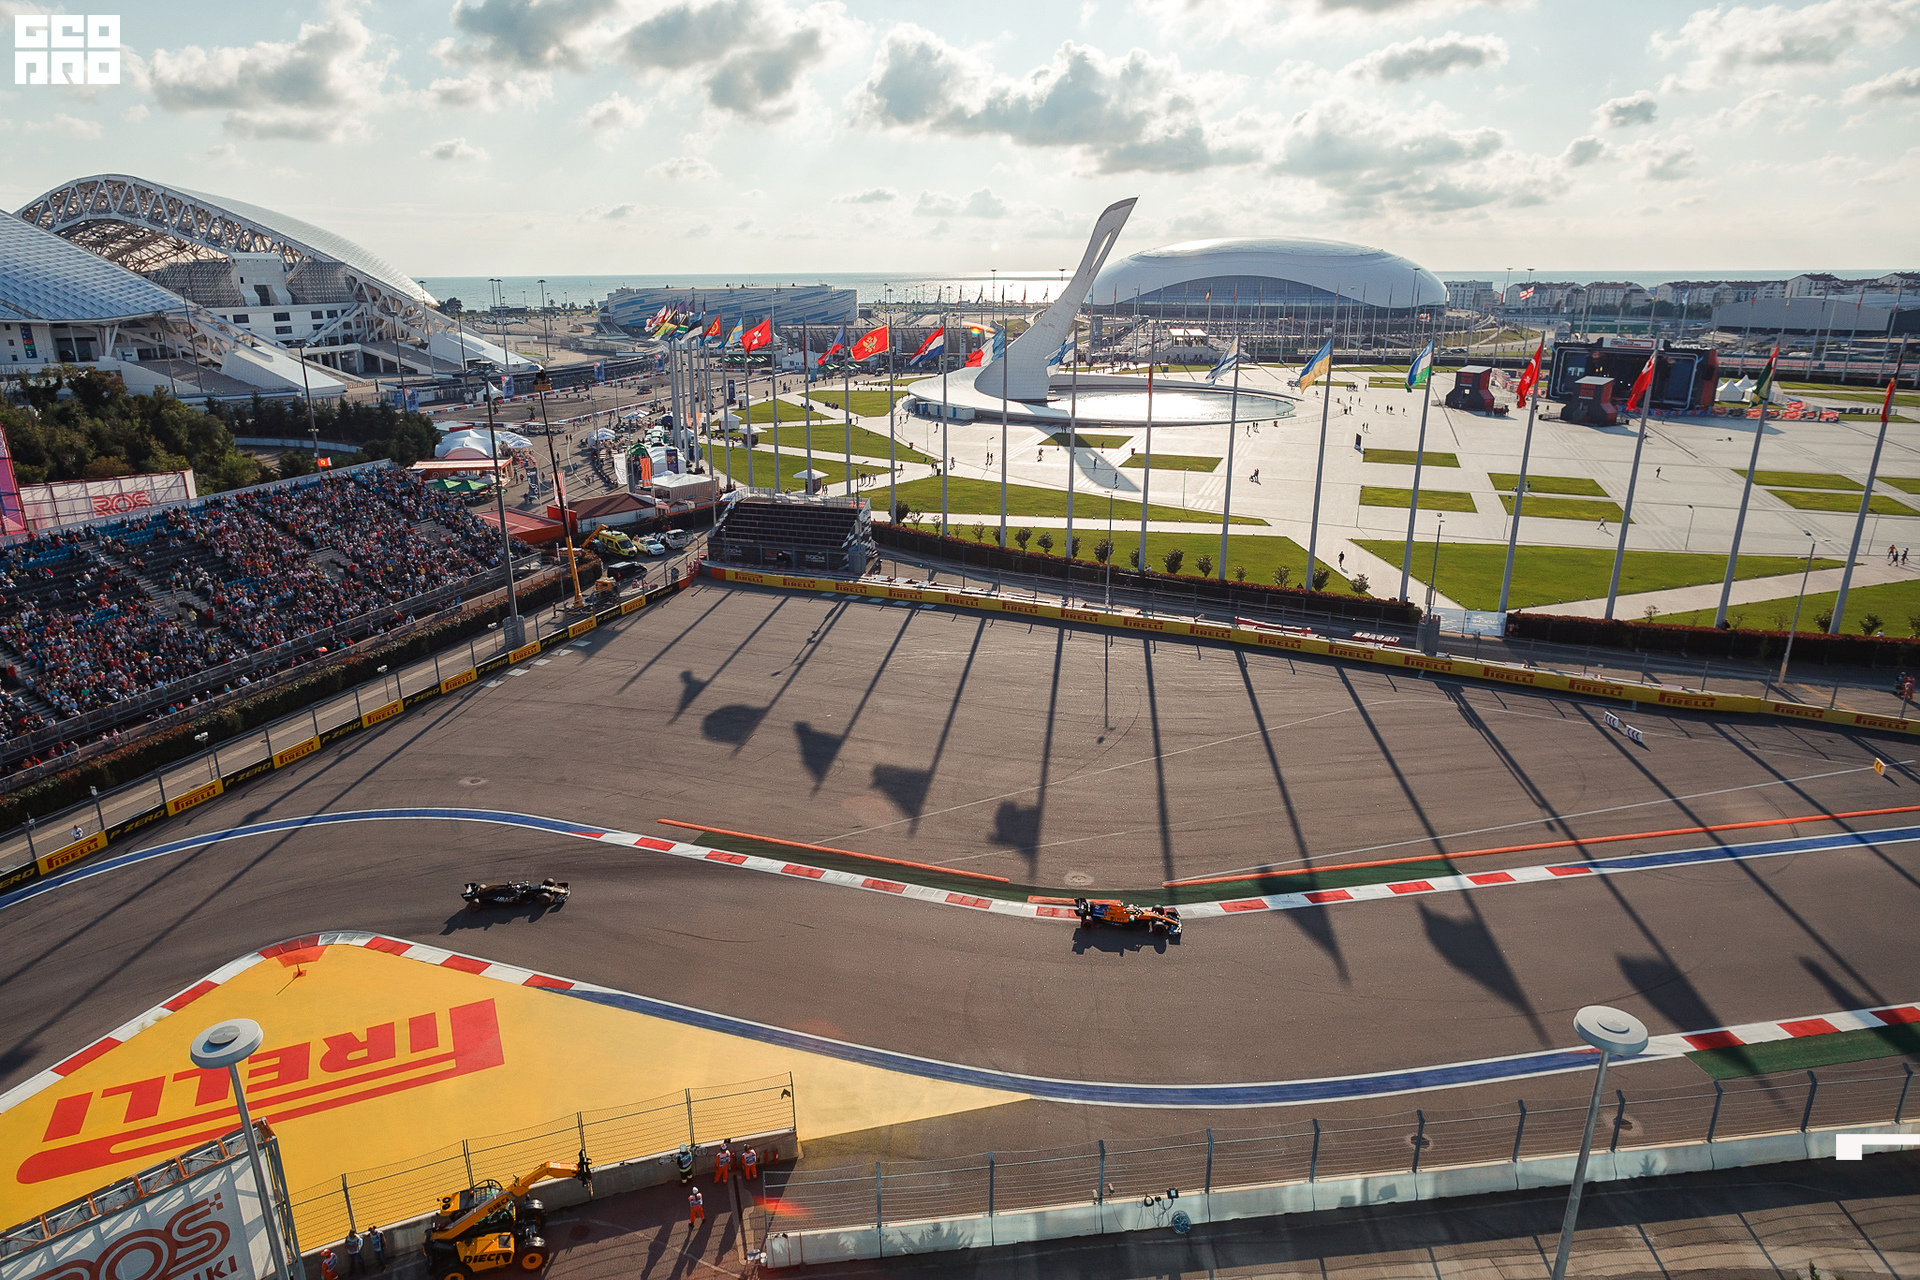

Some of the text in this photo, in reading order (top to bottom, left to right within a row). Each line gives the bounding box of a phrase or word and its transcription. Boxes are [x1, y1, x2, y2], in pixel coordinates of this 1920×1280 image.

[735, 572, 763, 583] PIRELLI
[783, 578, 815, 588] PIRELLI
[836, 583, 867, 594] PIRELLI
[889, 589, 922, 600] PIRELLI
[624, 598, 643, 612] PIRELLI
[945, 594, 979, 606] PIRELLI
[1002, 601, 1038, 613] PIRELLI
[1061, 609, 1098, 622] PIRELLI
[572, 620, 594, 635] PIRELLI
[1124, 617, 1163, 630] PIRELLI
[1190, 625, 1231, 638] PIRELLI
[1258, 634, 1301, 649] PIRELLI
[513, 645, 537, 661] PIRELLI
[1328, 644, 1374, 660] PIRELLI
[1404, 656, 1452, 671] PIRELLI
[445, 672, 472, 690] PIRELLI
[1483, 667, 1535, 684] PIRELLI
[1569, 678, 1623, 696] PIRELLI
[414, 688, 440, 702] ZERO
[1659, 692, 1716, 708] PIRELLI
[368, 704, 398, 724] PIRELLI
[1774, 704, 1824, 718] PIRELLI
[332, 721, 361, 738] ZERO
[1855, 715, 1908, 730] PIRELLI
[279, 741, 314, 765] PIRELLI
[225, 762, 272, 786] P ZERO
[174, 784, 216, 812] PIRELLI
[110, 810, 165, 839] P ZERO
[46, 838, 98, 870] PIRELLI
[16, 998, 505, 1185] PIRELLI
[463, 1253, 501, 1265] DIECI
